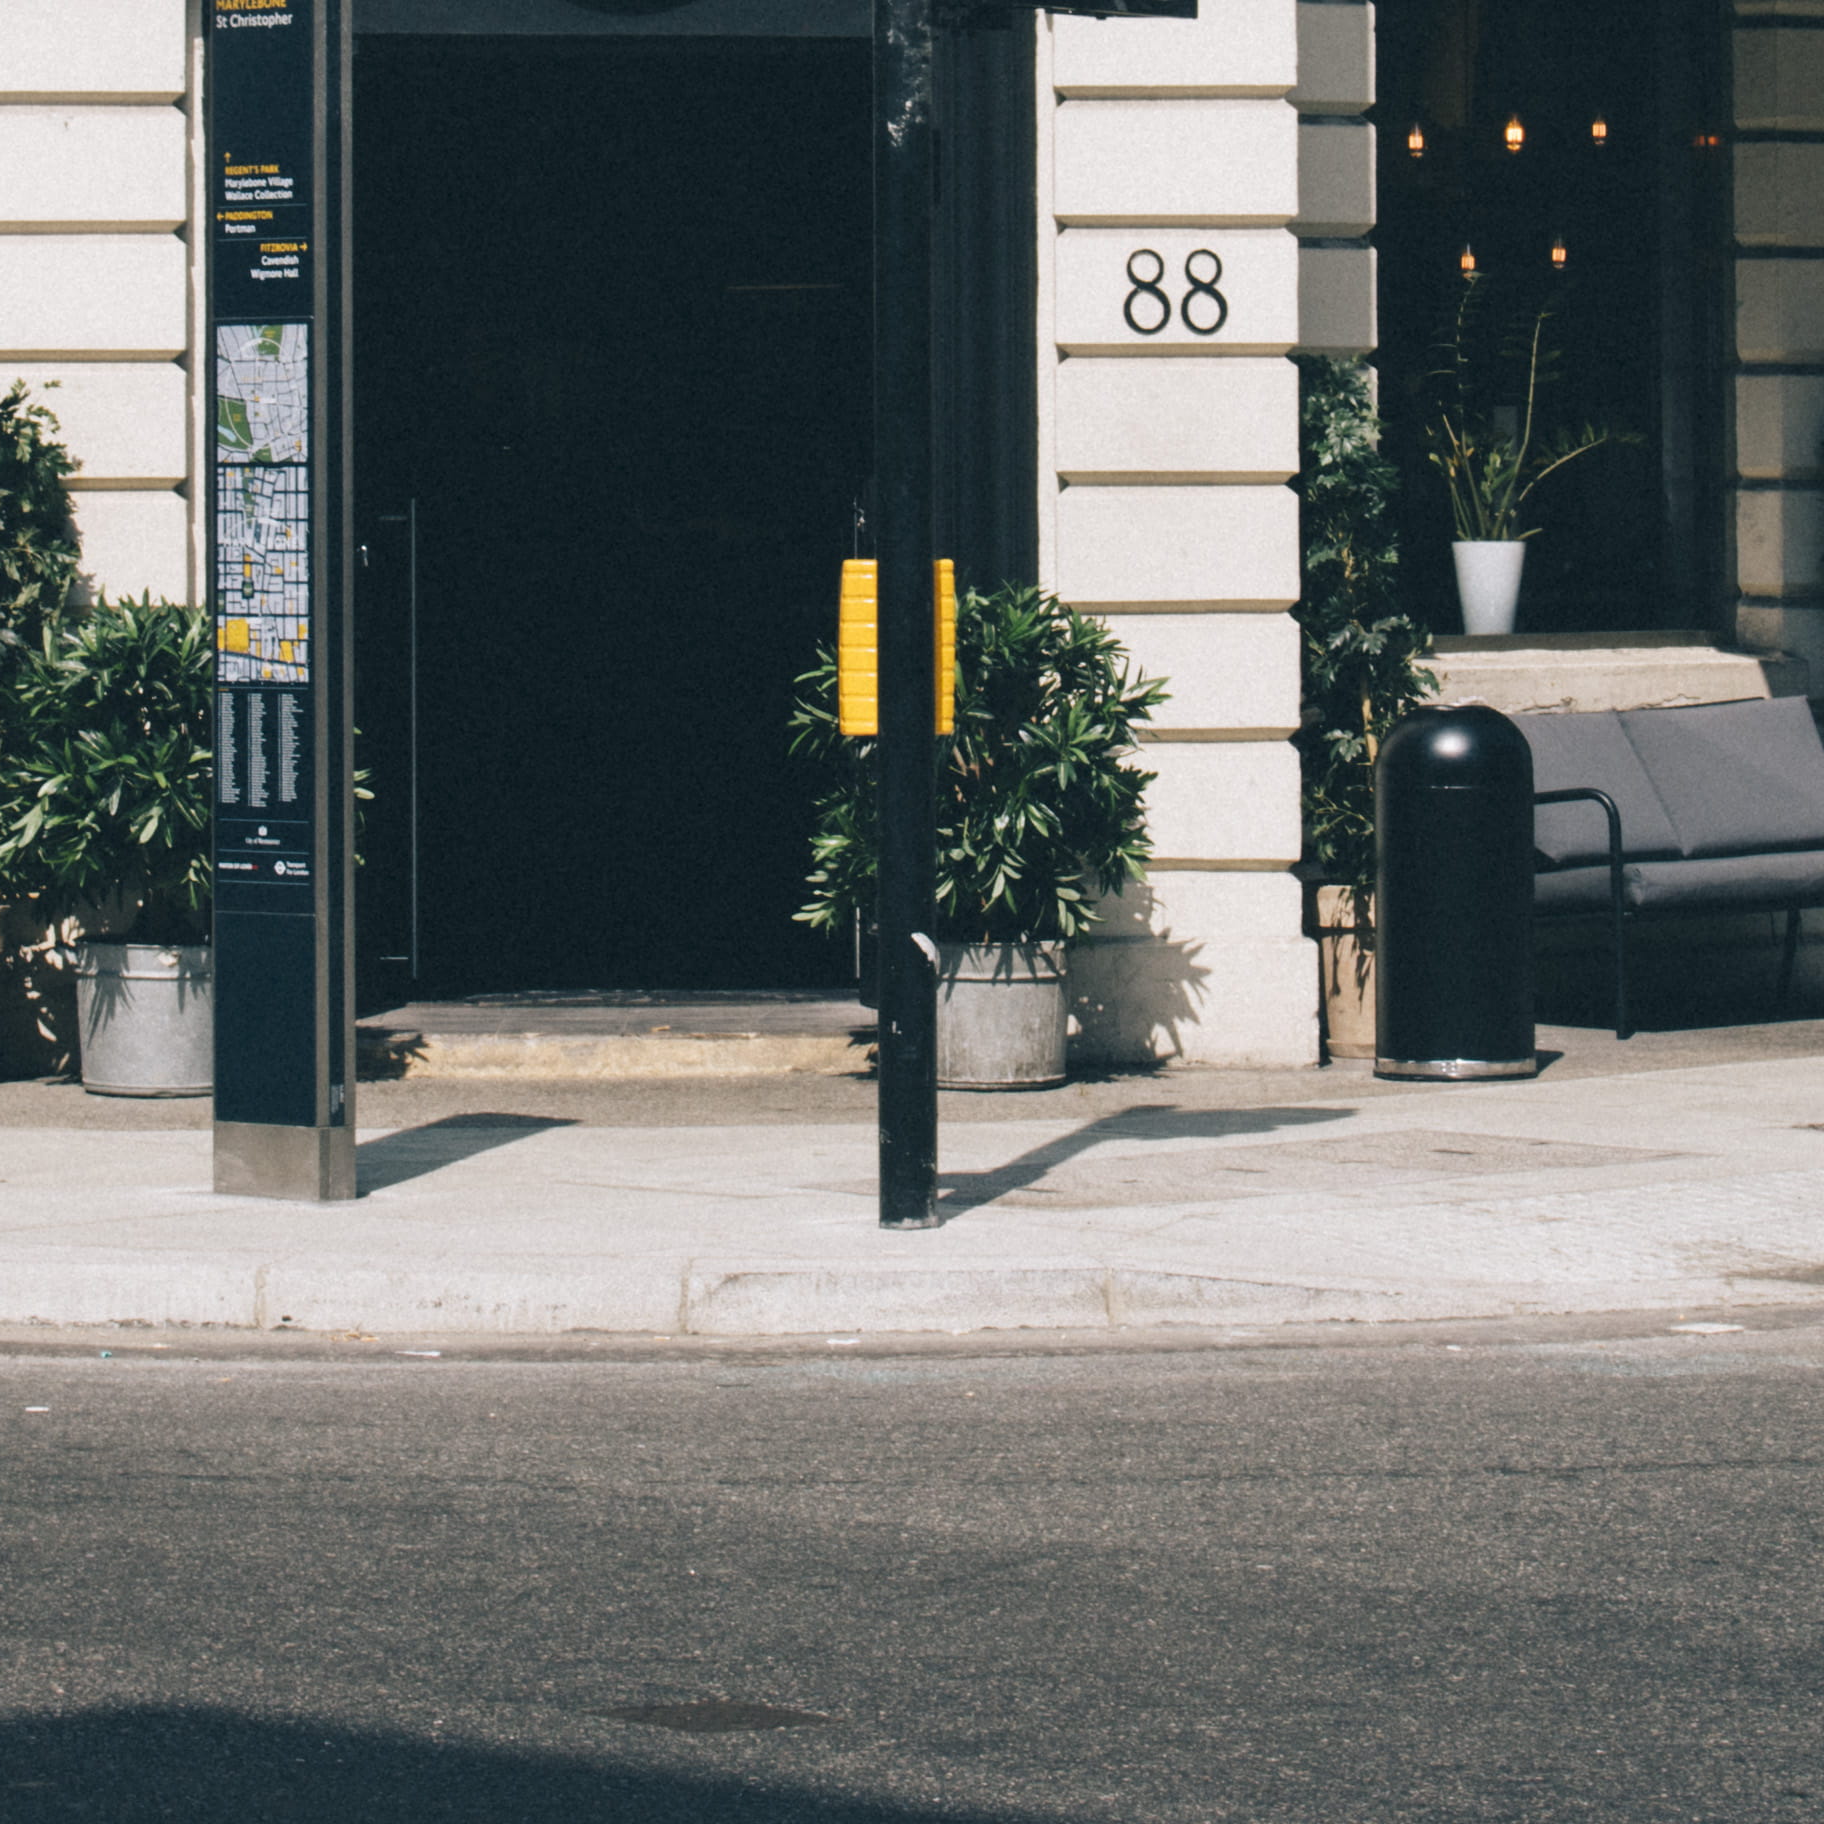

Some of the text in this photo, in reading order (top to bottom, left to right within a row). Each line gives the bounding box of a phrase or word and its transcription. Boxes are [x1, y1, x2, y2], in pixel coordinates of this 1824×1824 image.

[216, 12, 293, 29] St Christopher
[1122, 248, 1229, 336] 88
